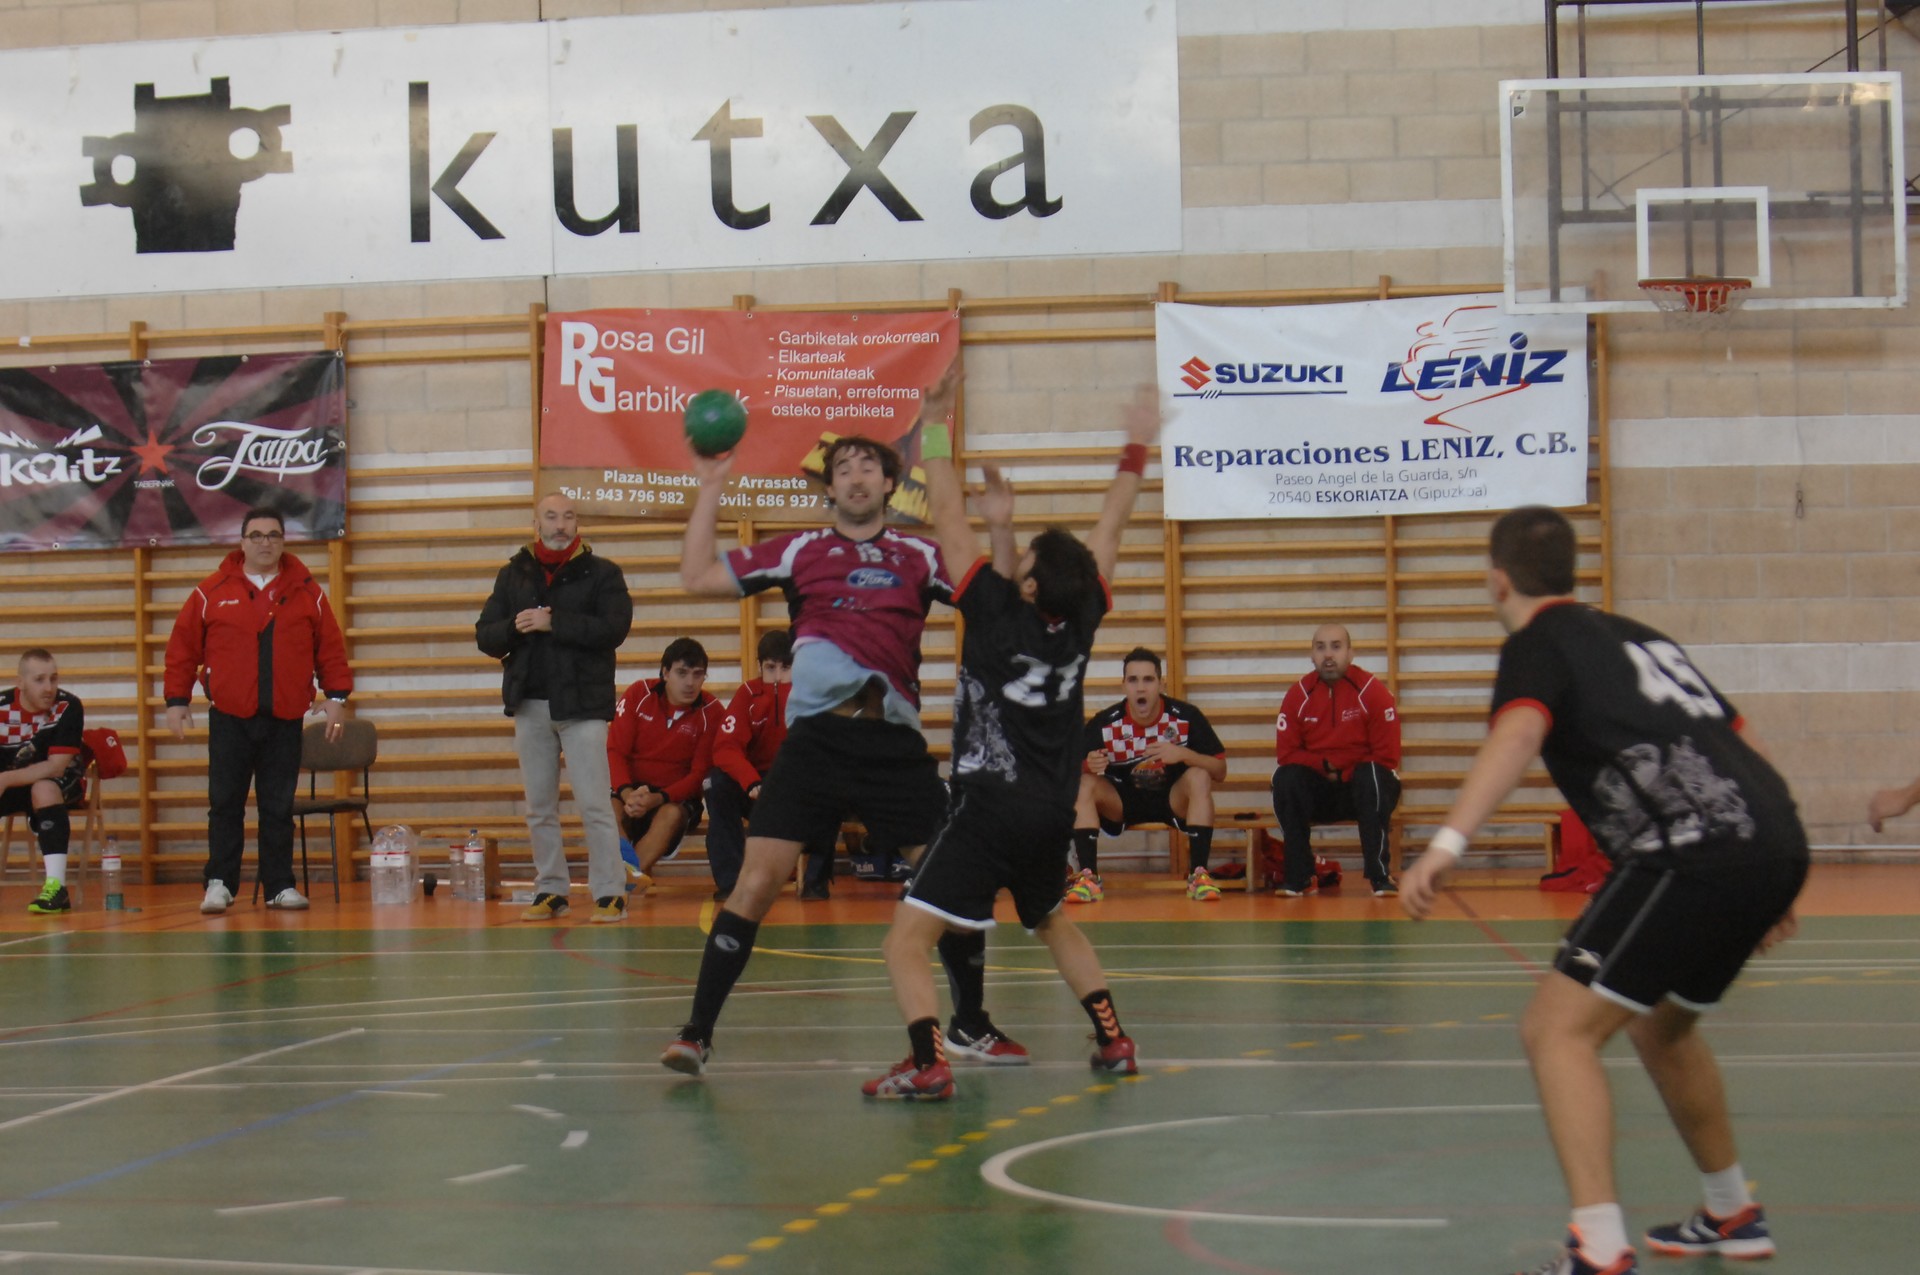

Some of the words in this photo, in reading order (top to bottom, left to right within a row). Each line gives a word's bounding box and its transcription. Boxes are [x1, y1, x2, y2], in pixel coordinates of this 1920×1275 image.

[408, 81, 1064, 243] kutxa
[779, 330, 859, 346] Garbiketak
[862, 331, 940, 346] orokorrean
[560, 321, 654, 386] Rosa
[665, 326, 705, 355] Gil
[779, 349, 846, 364] Elkarteak
[777, 367, 875, 381] Komunitateak
[1216, 361, 1343, 384] SUZUKI
[577, 356, 750, 413] Garbikk
[774, 384, 842, 400] Pisuetan,
[846, 384, 920, 399] erreforma
[771, 403, 821, 417] osteko
[825, 403, 895, 420] garbiketa
[1174, 440, 1390, 473] Reparaciones
[1400, 435, 1504, 461] LENIZ,
[1515, 431, 1577, 455] C.B.
[603, 469, 644, 484] Plaza
[738, 475, 808, 489] Arrasate
[1275, 473, 1313, 486] Paseo
[1317, 471, 1357, 488] Angel
[1361, 470, 1378, 484] de
[1382, 469, 1394, 482] la
[1398, 467, 1453, 482] Guarda,
[1458, 466, 1478, 479] s/n
[559, 486, 591, 500] Tel.:
[595, 488, 623, 501] 943
[628, 489, 655, 503] 796
[659, 490, 685, 504] 982
[719, 492, 752, 507] óvil:
[756, 494, 785, 507] 686
[789, 494, 818, 508] 937
[1268, 490, 1311, 504] 20540
[1315, 488, 1409, 503] ESKORIATZA
[615, 698, 626, 718] 4
[721, 715, 737, 734] 3
[1276, 712, 1288, 731] 6
